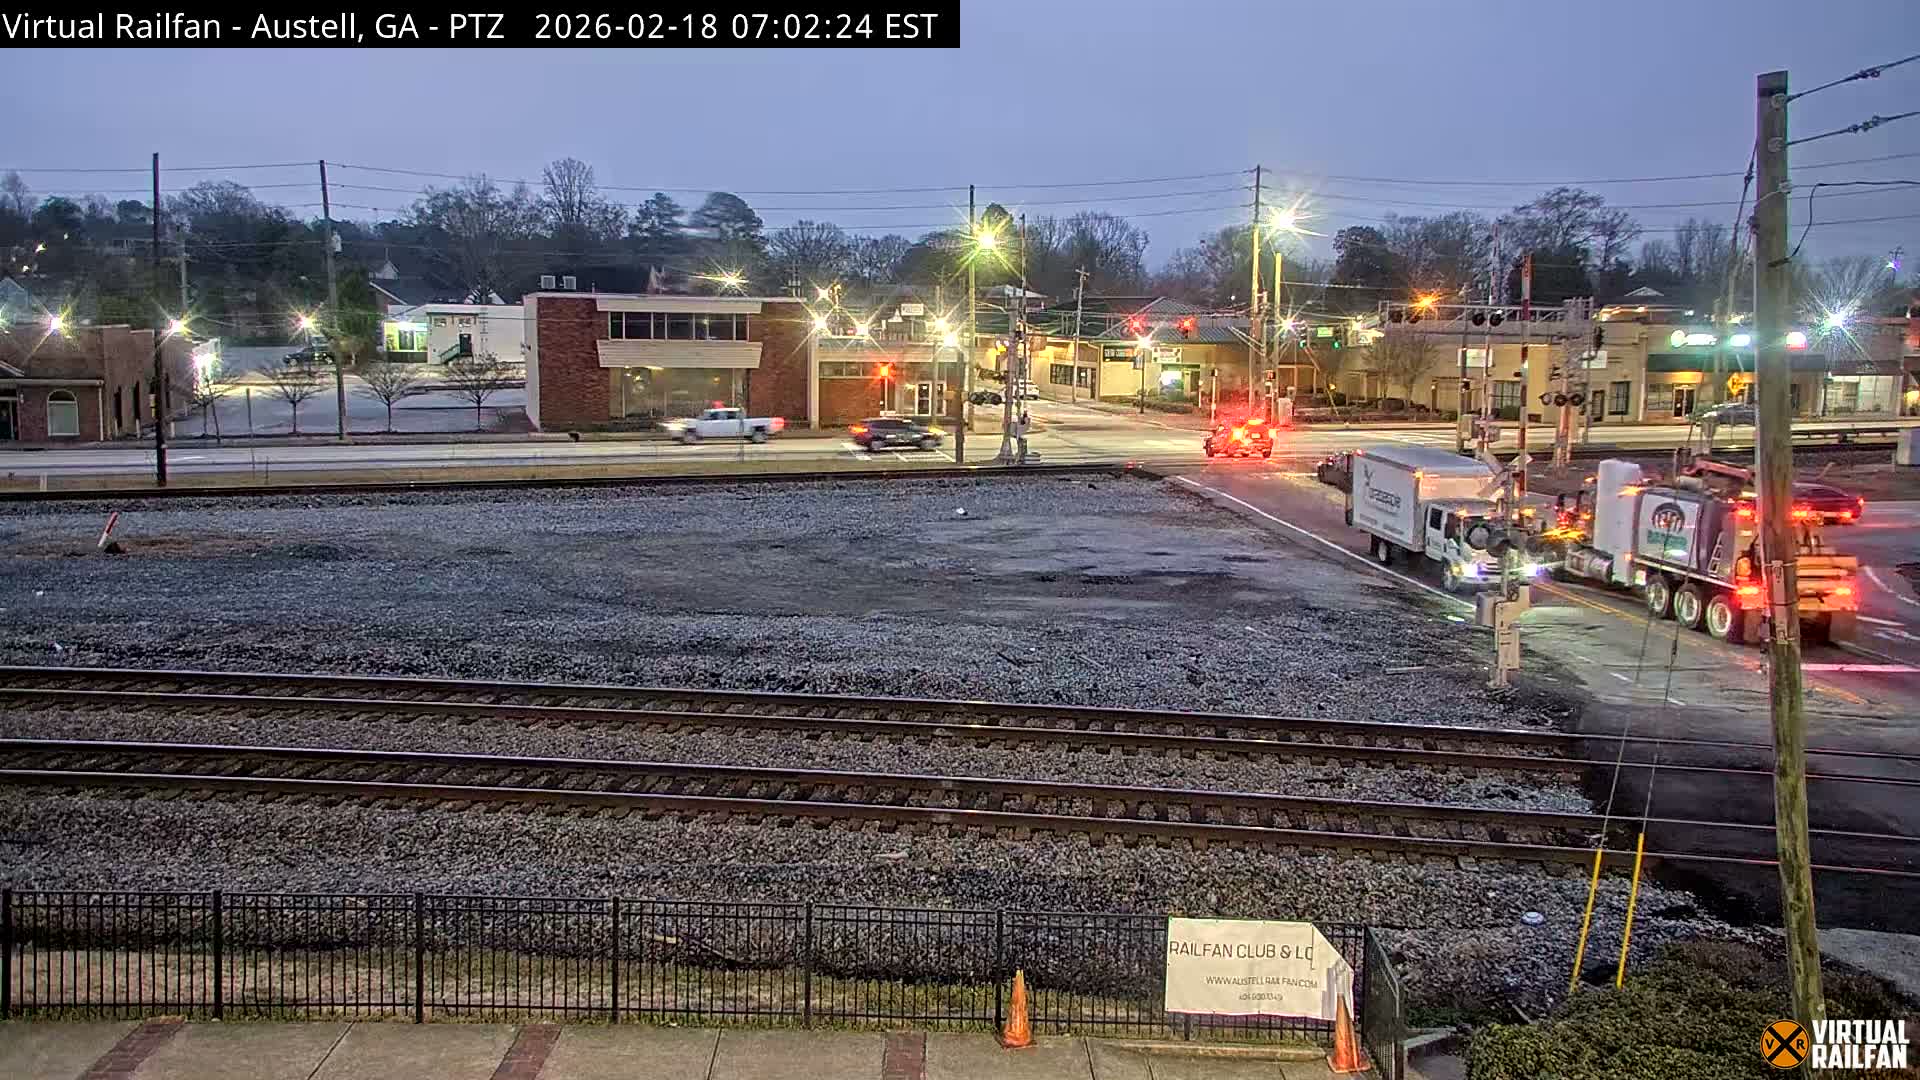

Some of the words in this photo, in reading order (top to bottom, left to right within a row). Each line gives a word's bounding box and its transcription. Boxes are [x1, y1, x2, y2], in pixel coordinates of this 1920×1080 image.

[1169, 941, 1233, 959] RAILFAN
[1236, 943, 1276, 959] CLUB
[1280, 944, 1292, 959] &
